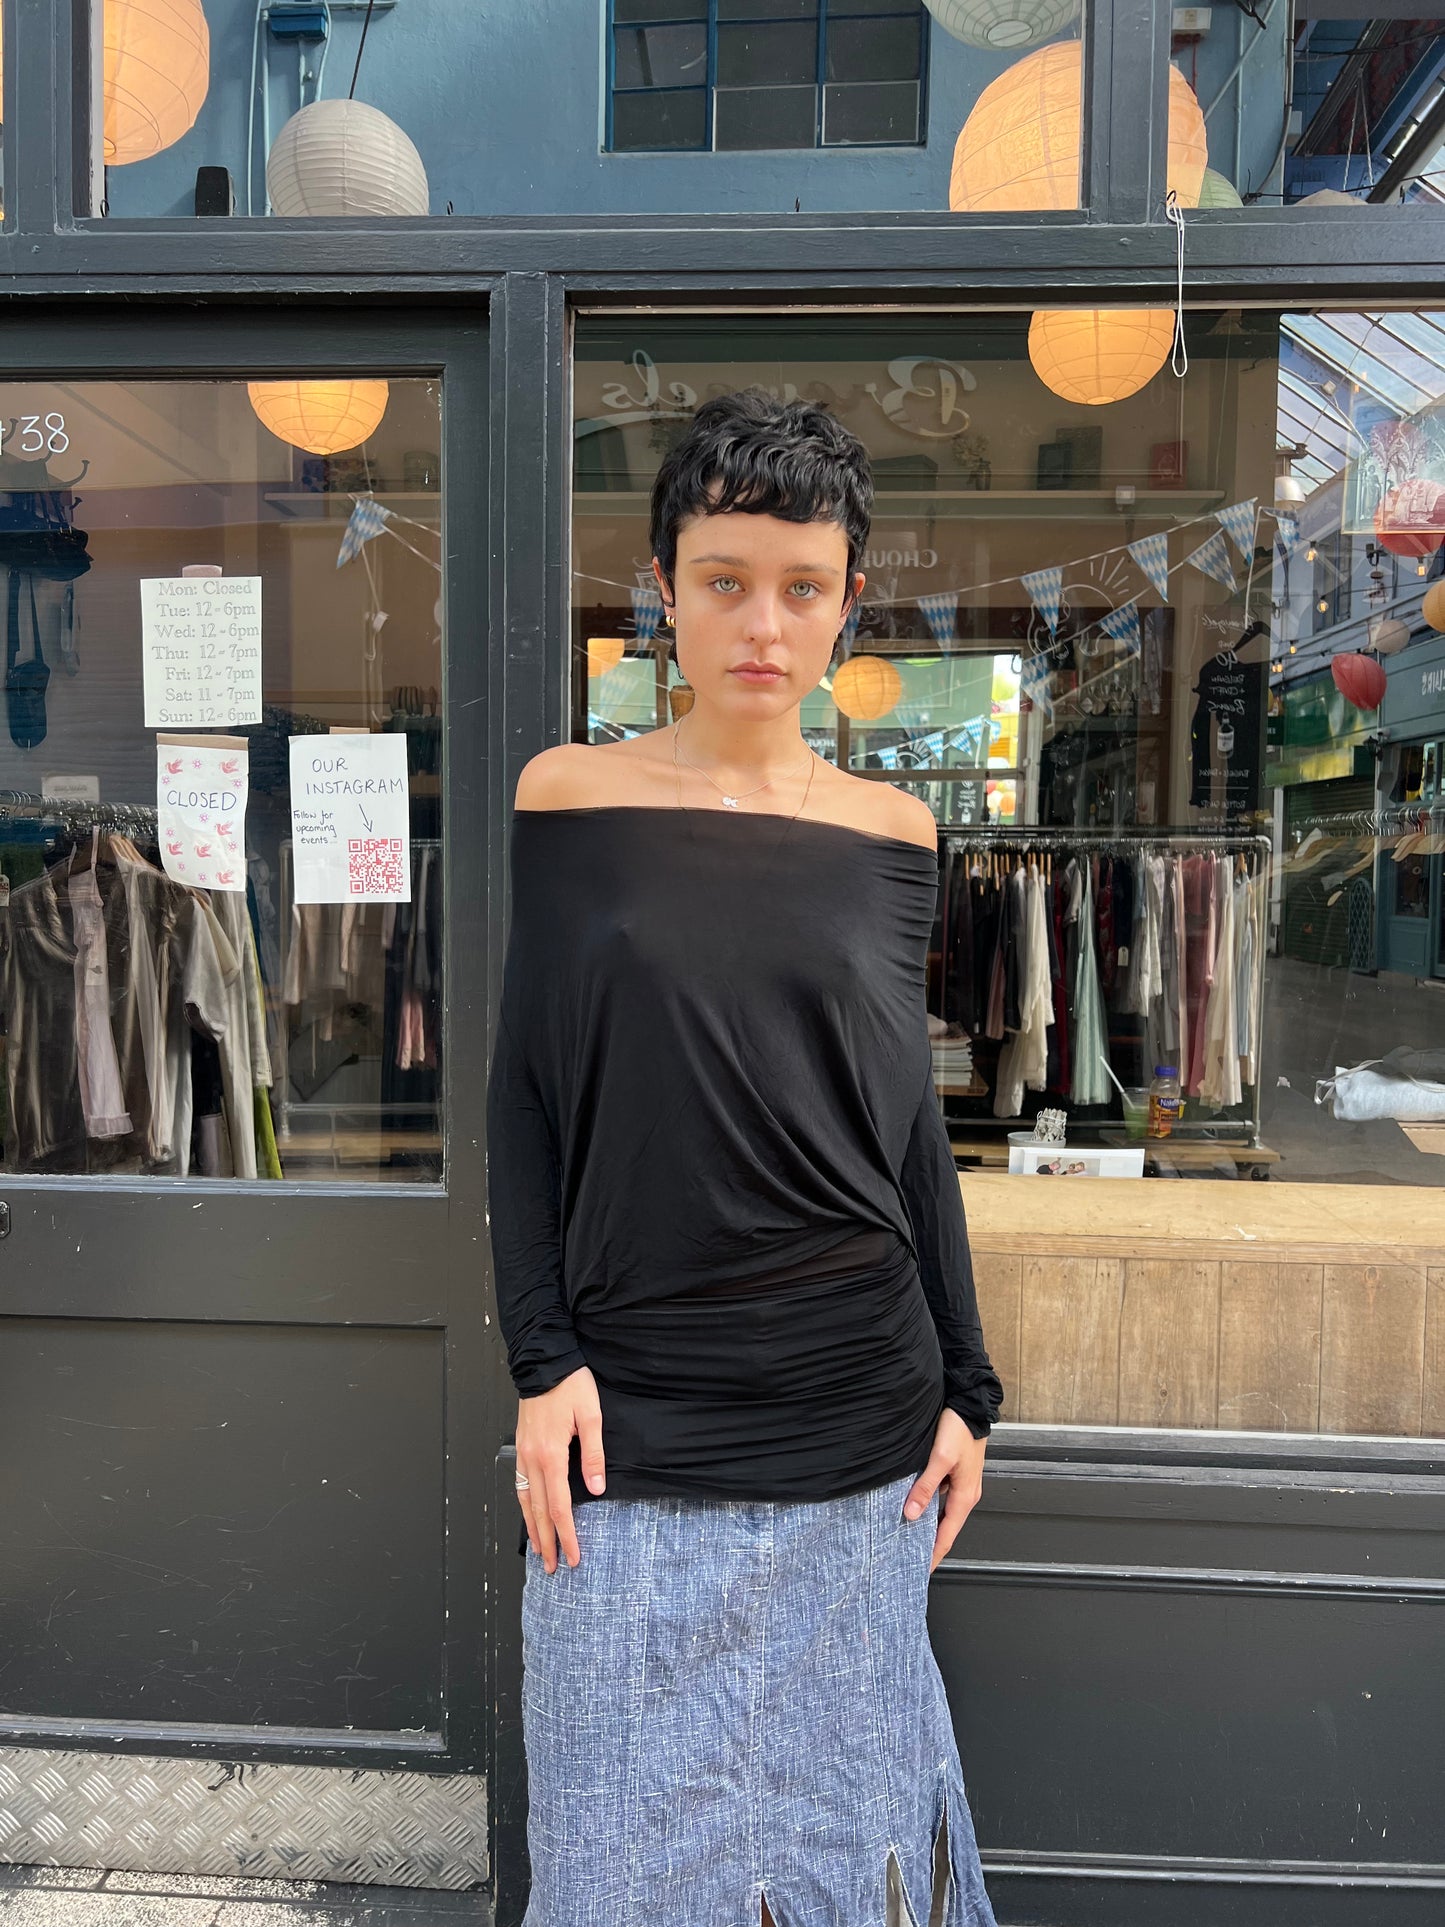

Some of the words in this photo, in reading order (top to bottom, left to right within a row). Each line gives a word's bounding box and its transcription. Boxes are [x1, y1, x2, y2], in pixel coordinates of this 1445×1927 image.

[21, 412, 69, 453] 38
[158, 582, 198, 596] Mon:
[203, 580, 253, 595] Closed
[156, 603, 190, 617] Tue:
[154, 624, 195, 638] Wed:
[152, 646, 189, 659] Thu:
[165, 667, 191, 680] Fri:
[165, 688, 193, 701] Sat:
[159, 709, 193, 722] Sun:
[312, 757, 348, 773] OUR
[306, 778, 404, 795] INSTAGRAM
[167, 790, 237, 811] CLOSED
[293, 810, 317, 820] Follow
[320, 810, 334, 826] for
[296, 824, 337, 838] upcoming
